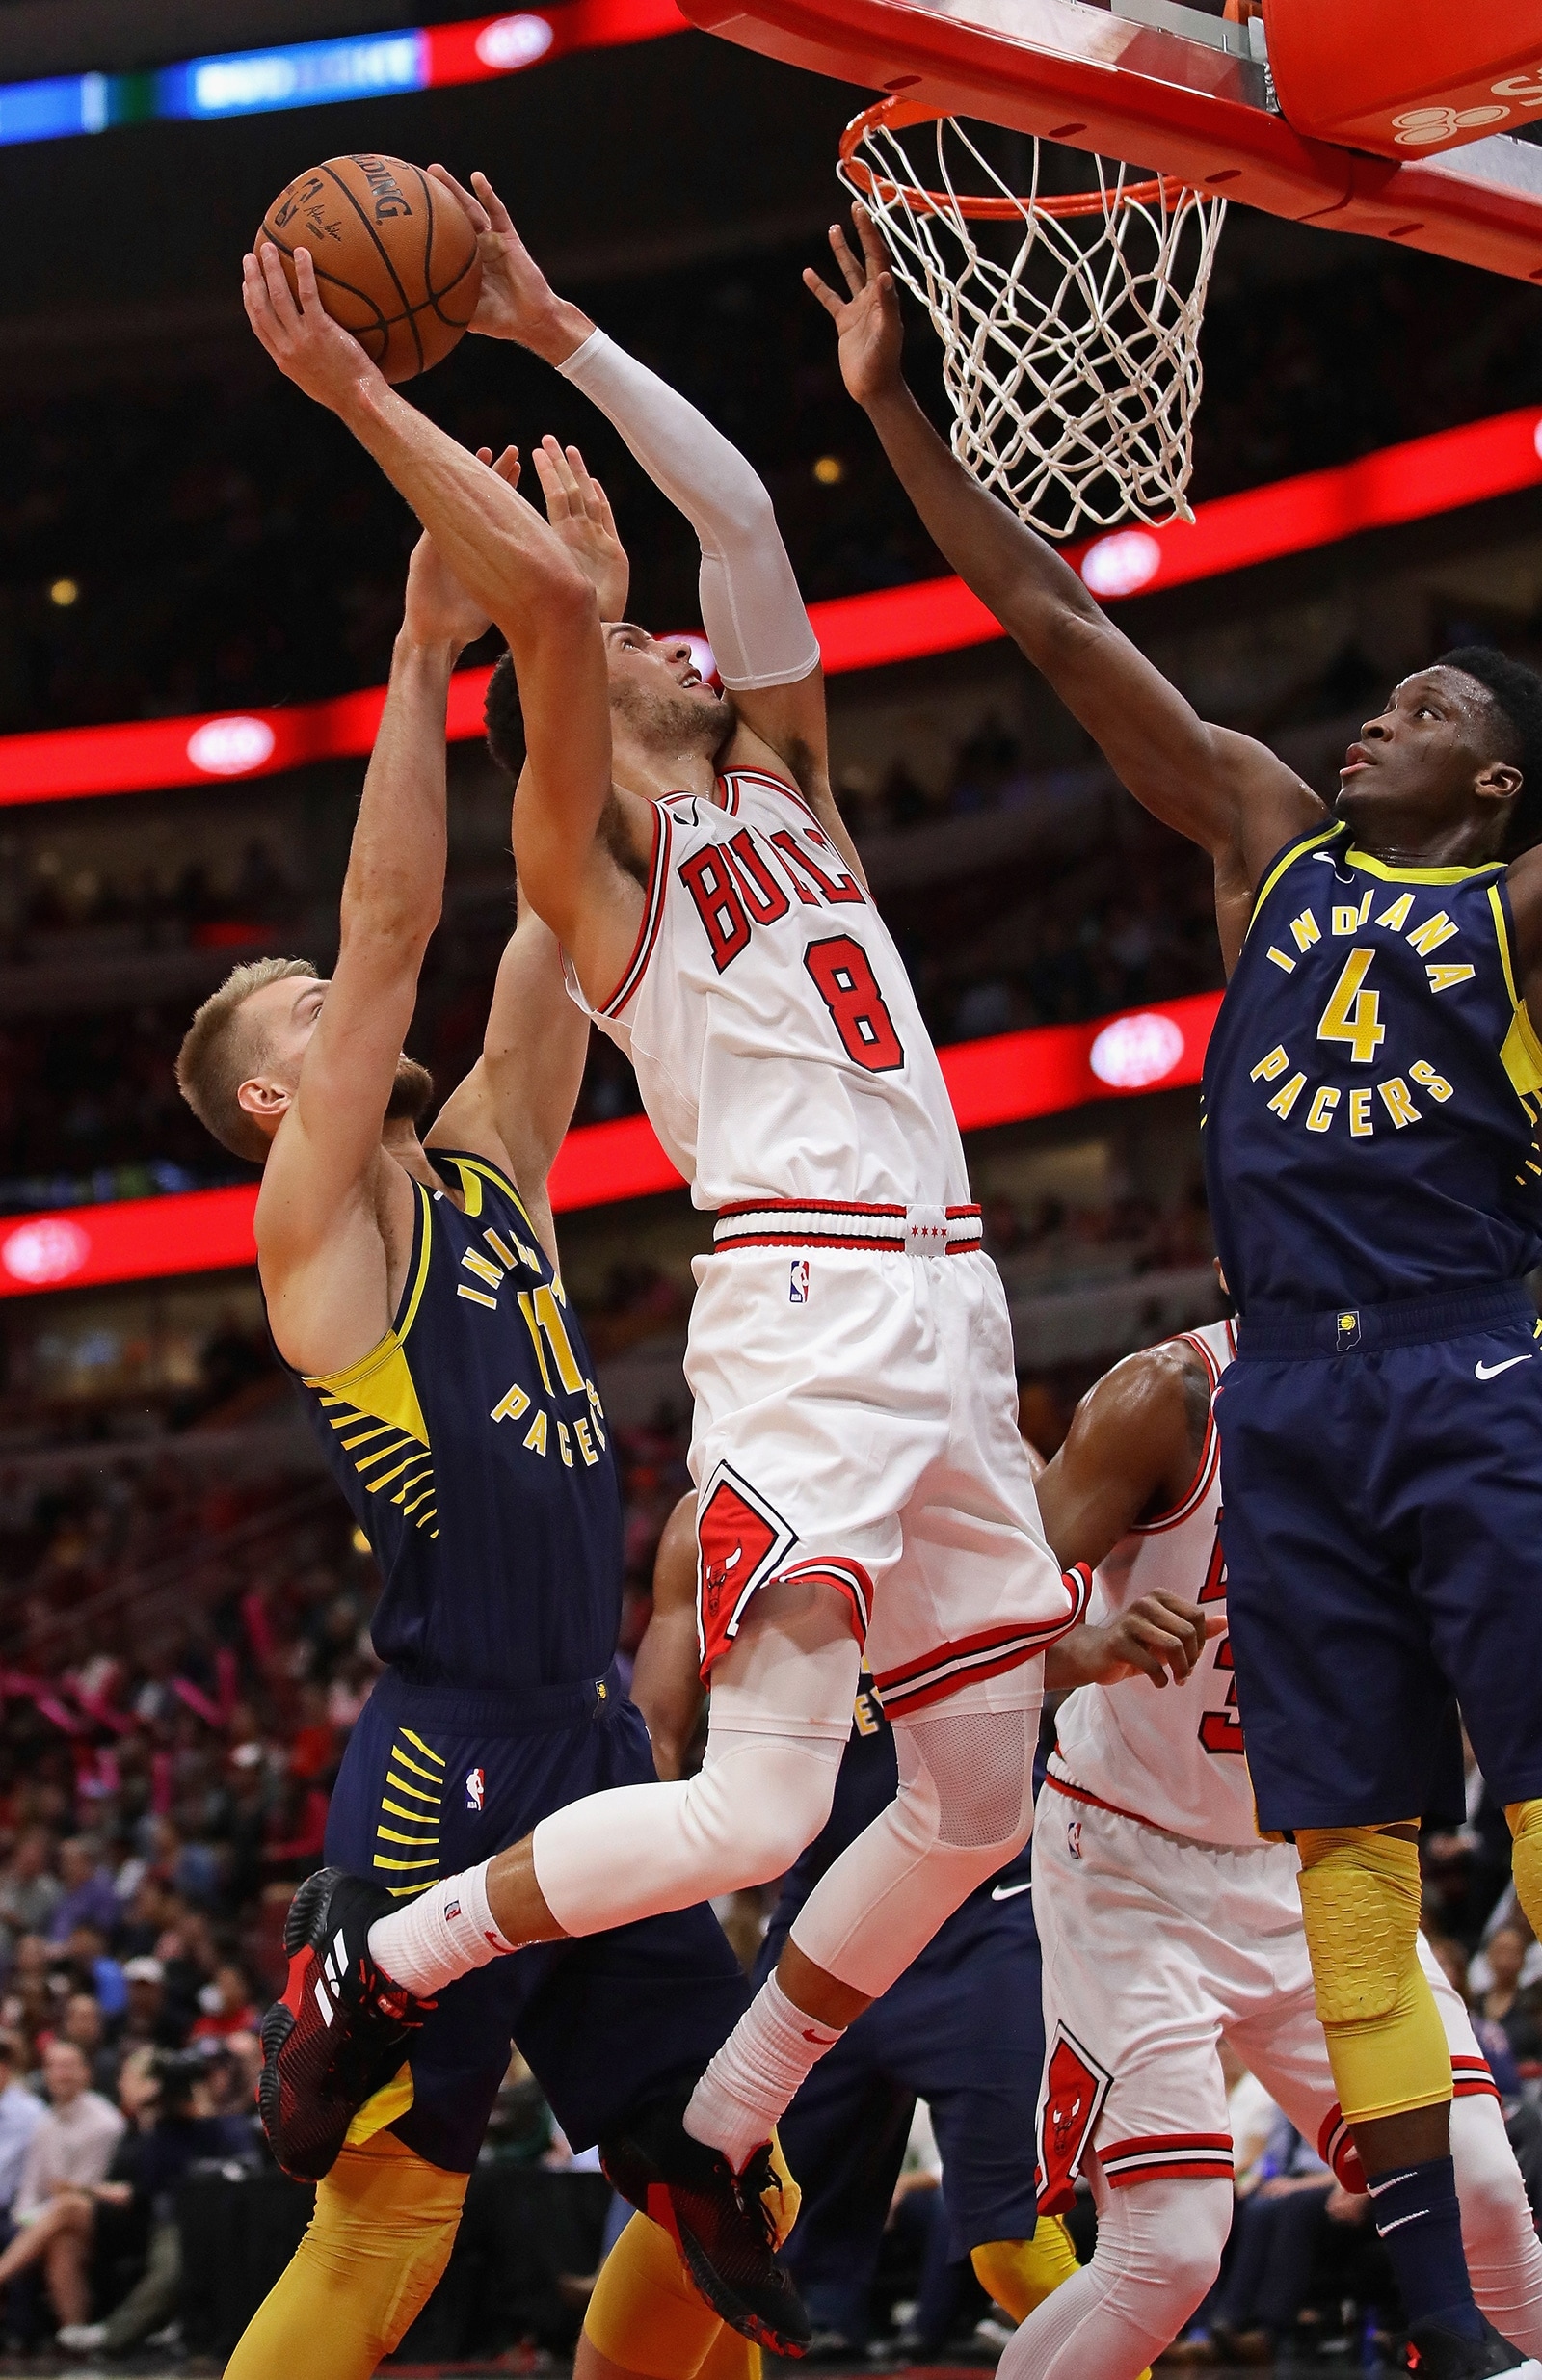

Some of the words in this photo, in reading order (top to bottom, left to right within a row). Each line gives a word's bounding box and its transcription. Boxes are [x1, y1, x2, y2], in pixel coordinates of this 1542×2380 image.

[1266, 889, 1476, 993] INDIANA
[803, 934, 904, 1073] 8
[1317, 948, 1385, 1062] 4
[1250, 1045, 1453, 1137] PACERS
